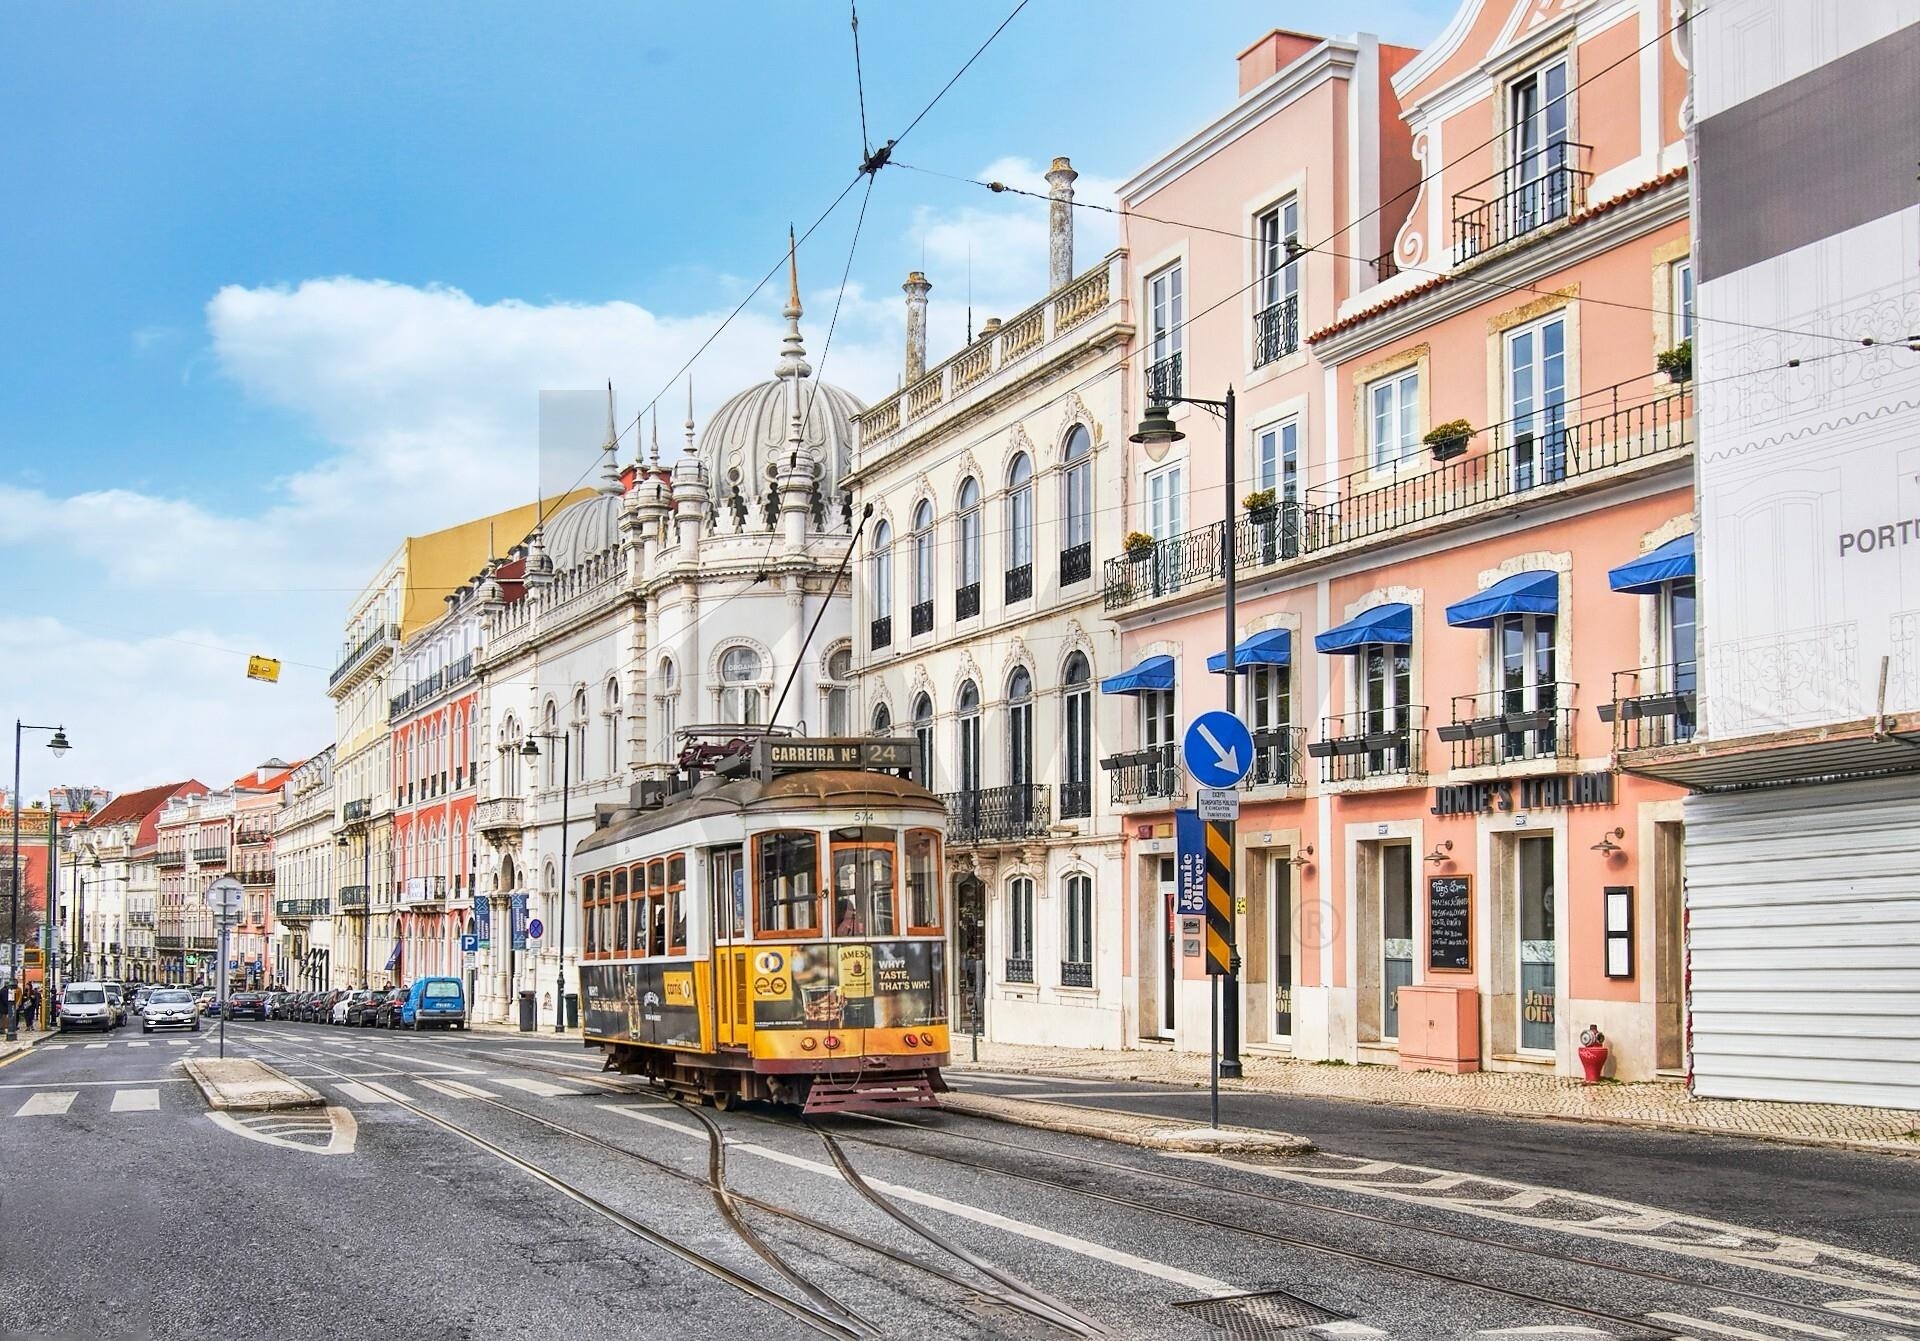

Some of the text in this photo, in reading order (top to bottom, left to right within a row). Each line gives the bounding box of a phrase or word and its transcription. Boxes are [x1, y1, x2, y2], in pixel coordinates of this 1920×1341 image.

[771, 745, 896, 762] CARREIRA Nº 24
[1431, 772, 1614, 816] JAMIE'S ITALIAN
[854, 811, 874, 822] 574
[1180, 853, 1193, 910] Jamie
[1192, 853, 1204, 911] Oliver
[464, 936, 475, 950] P
[878, 959, 906, 969] WHY?
[878, 970, 910, 980] TASTE,
[879, 981, 910, 991] THAT'S
